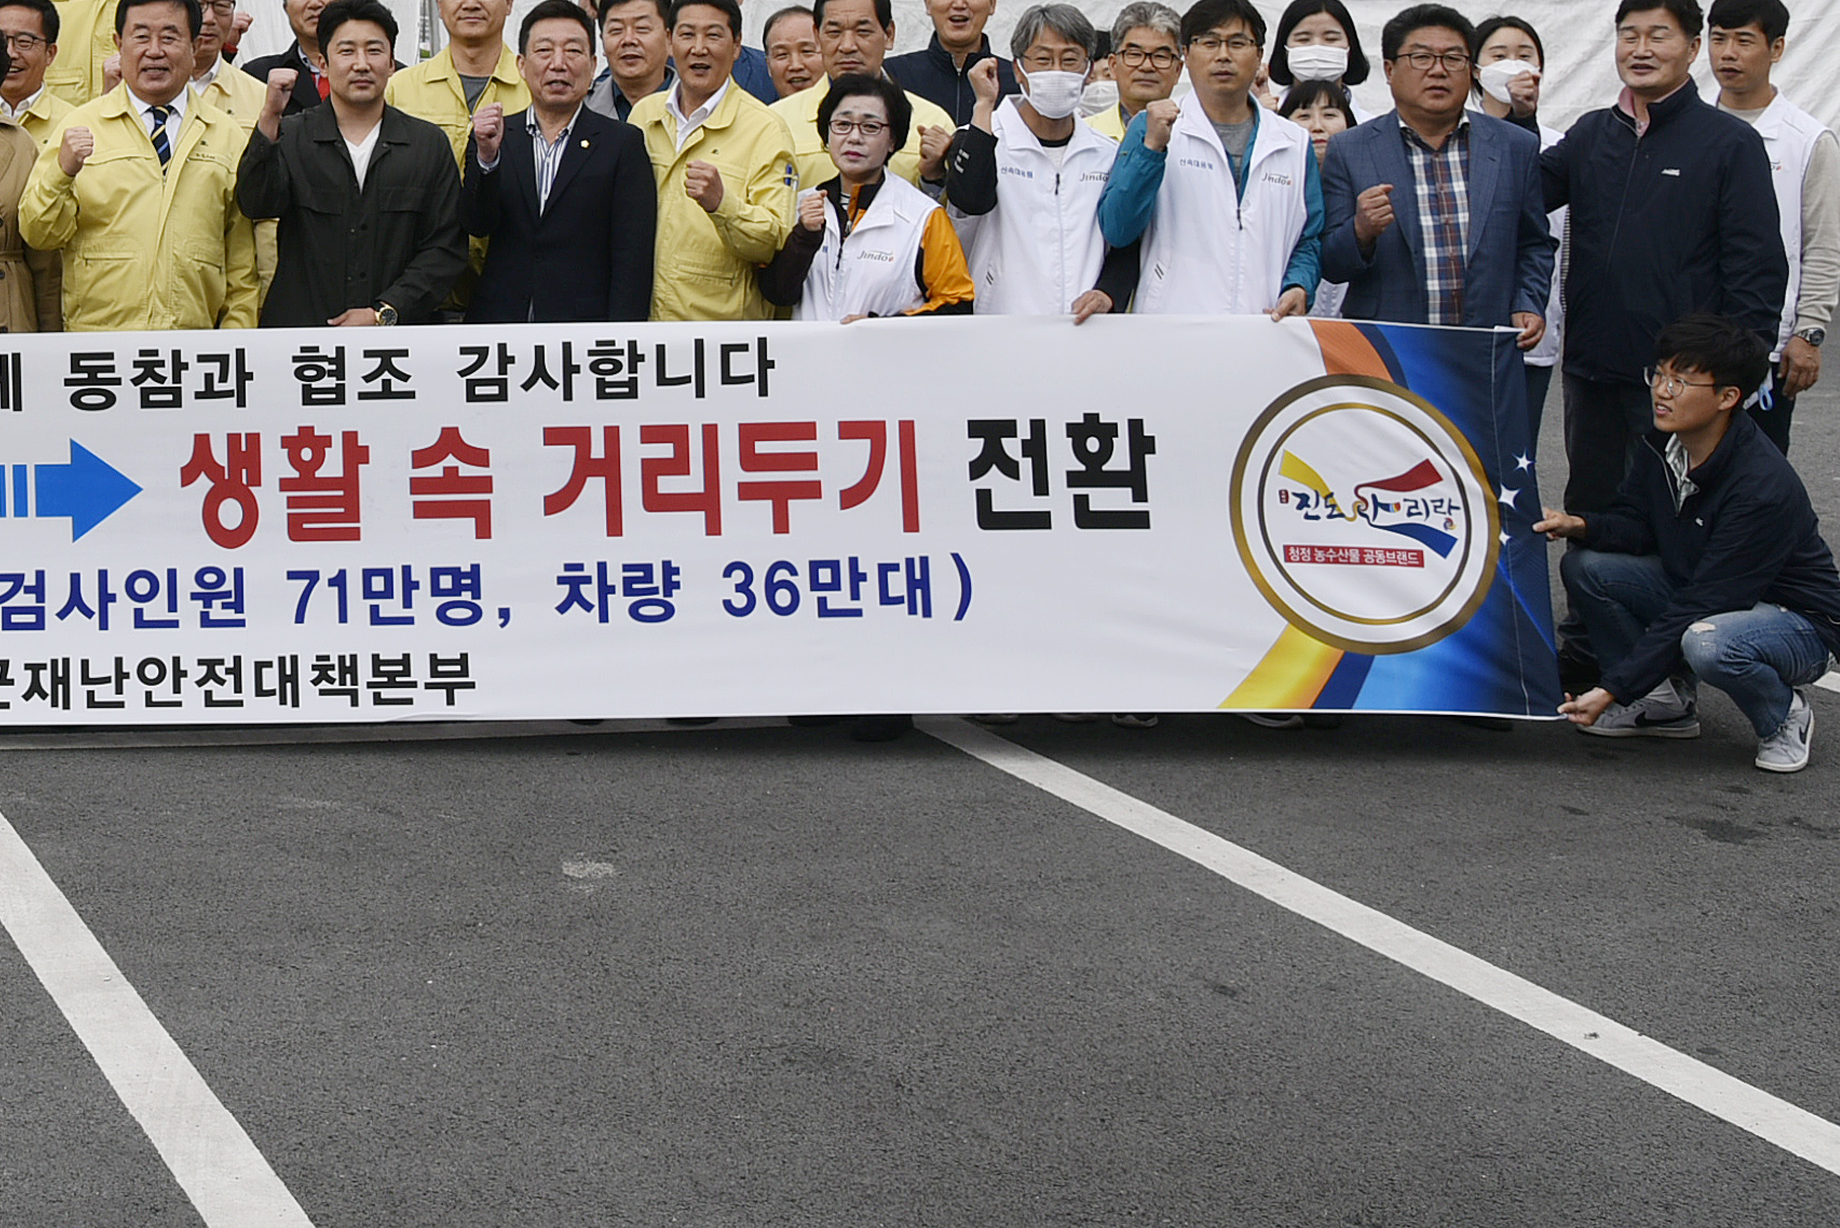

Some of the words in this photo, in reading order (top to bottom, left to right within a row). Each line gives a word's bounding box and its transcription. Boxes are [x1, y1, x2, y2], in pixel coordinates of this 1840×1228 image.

[857, 250, 888, 262] Jindo
[63, 347, 254, 412] 동참과
[291, 345, 417, 406] 협조
[456, 336, 776, 403] 감사합니다
[179, 425, 370, 550] 생활
[409, 426, 494, 540] 속
[542, 419, 920, 538] 거리두기
[966, 412, 1157, 531] 전환
[286, 563, 511, 629] 71만명,
[555, 559, 681, 624] 차량
[722, 553, 973, 621] 36만대)
[1288, 546, 1311, 561] 청정
[1314, 547, 1360, 563] 농수산물
[1363, 549, 1420, 565] 공동브랜드
